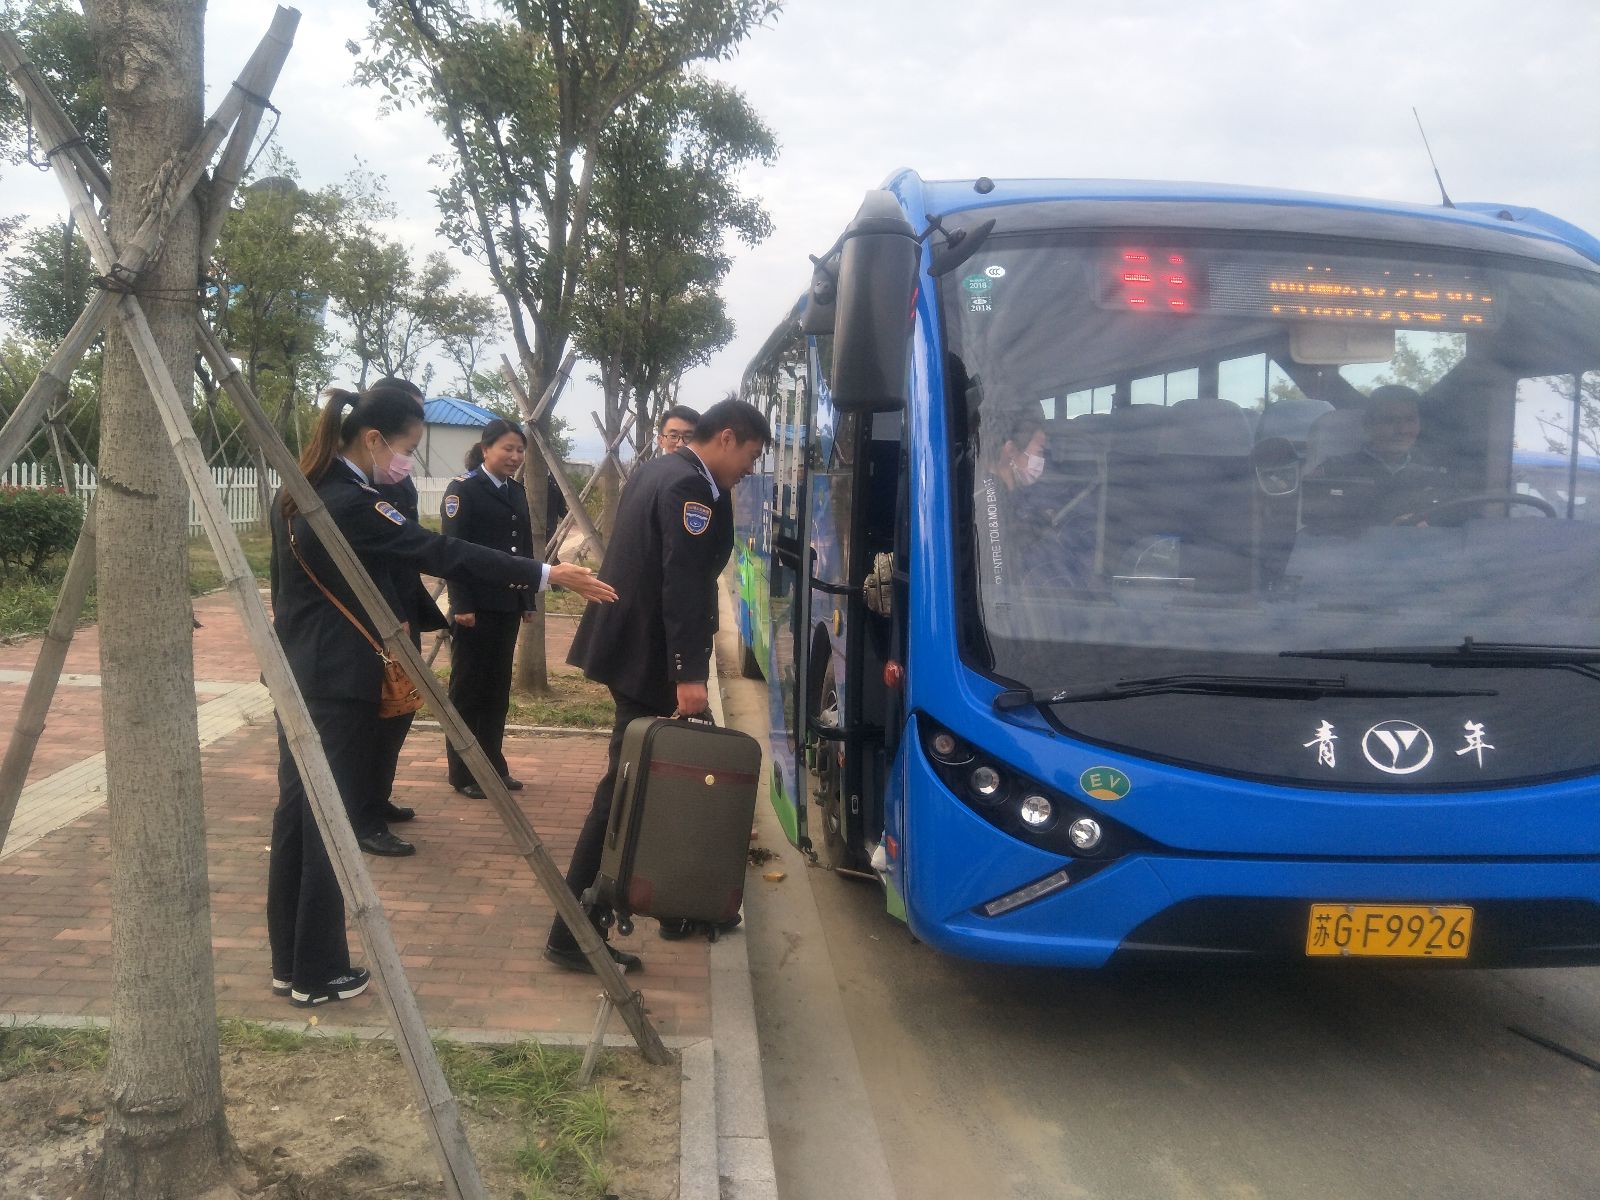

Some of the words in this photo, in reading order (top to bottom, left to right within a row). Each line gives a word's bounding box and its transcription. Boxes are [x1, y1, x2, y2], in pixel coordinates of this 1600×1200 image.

[970, 304, 992, 312] 2018
[987, 504, 998, 520] MOI
[988, 520, 999, 528] &
[989, 529, 1000, 545] TOI
[991, 545, 1003, 575] ENTRE
[1303, 719, 1338, 768] 青
[1455, 719, 1495, 769] 年
[1090, 773, 1121, 788] EV
[1313, 913, 1465, 950] 苏G·F9926
